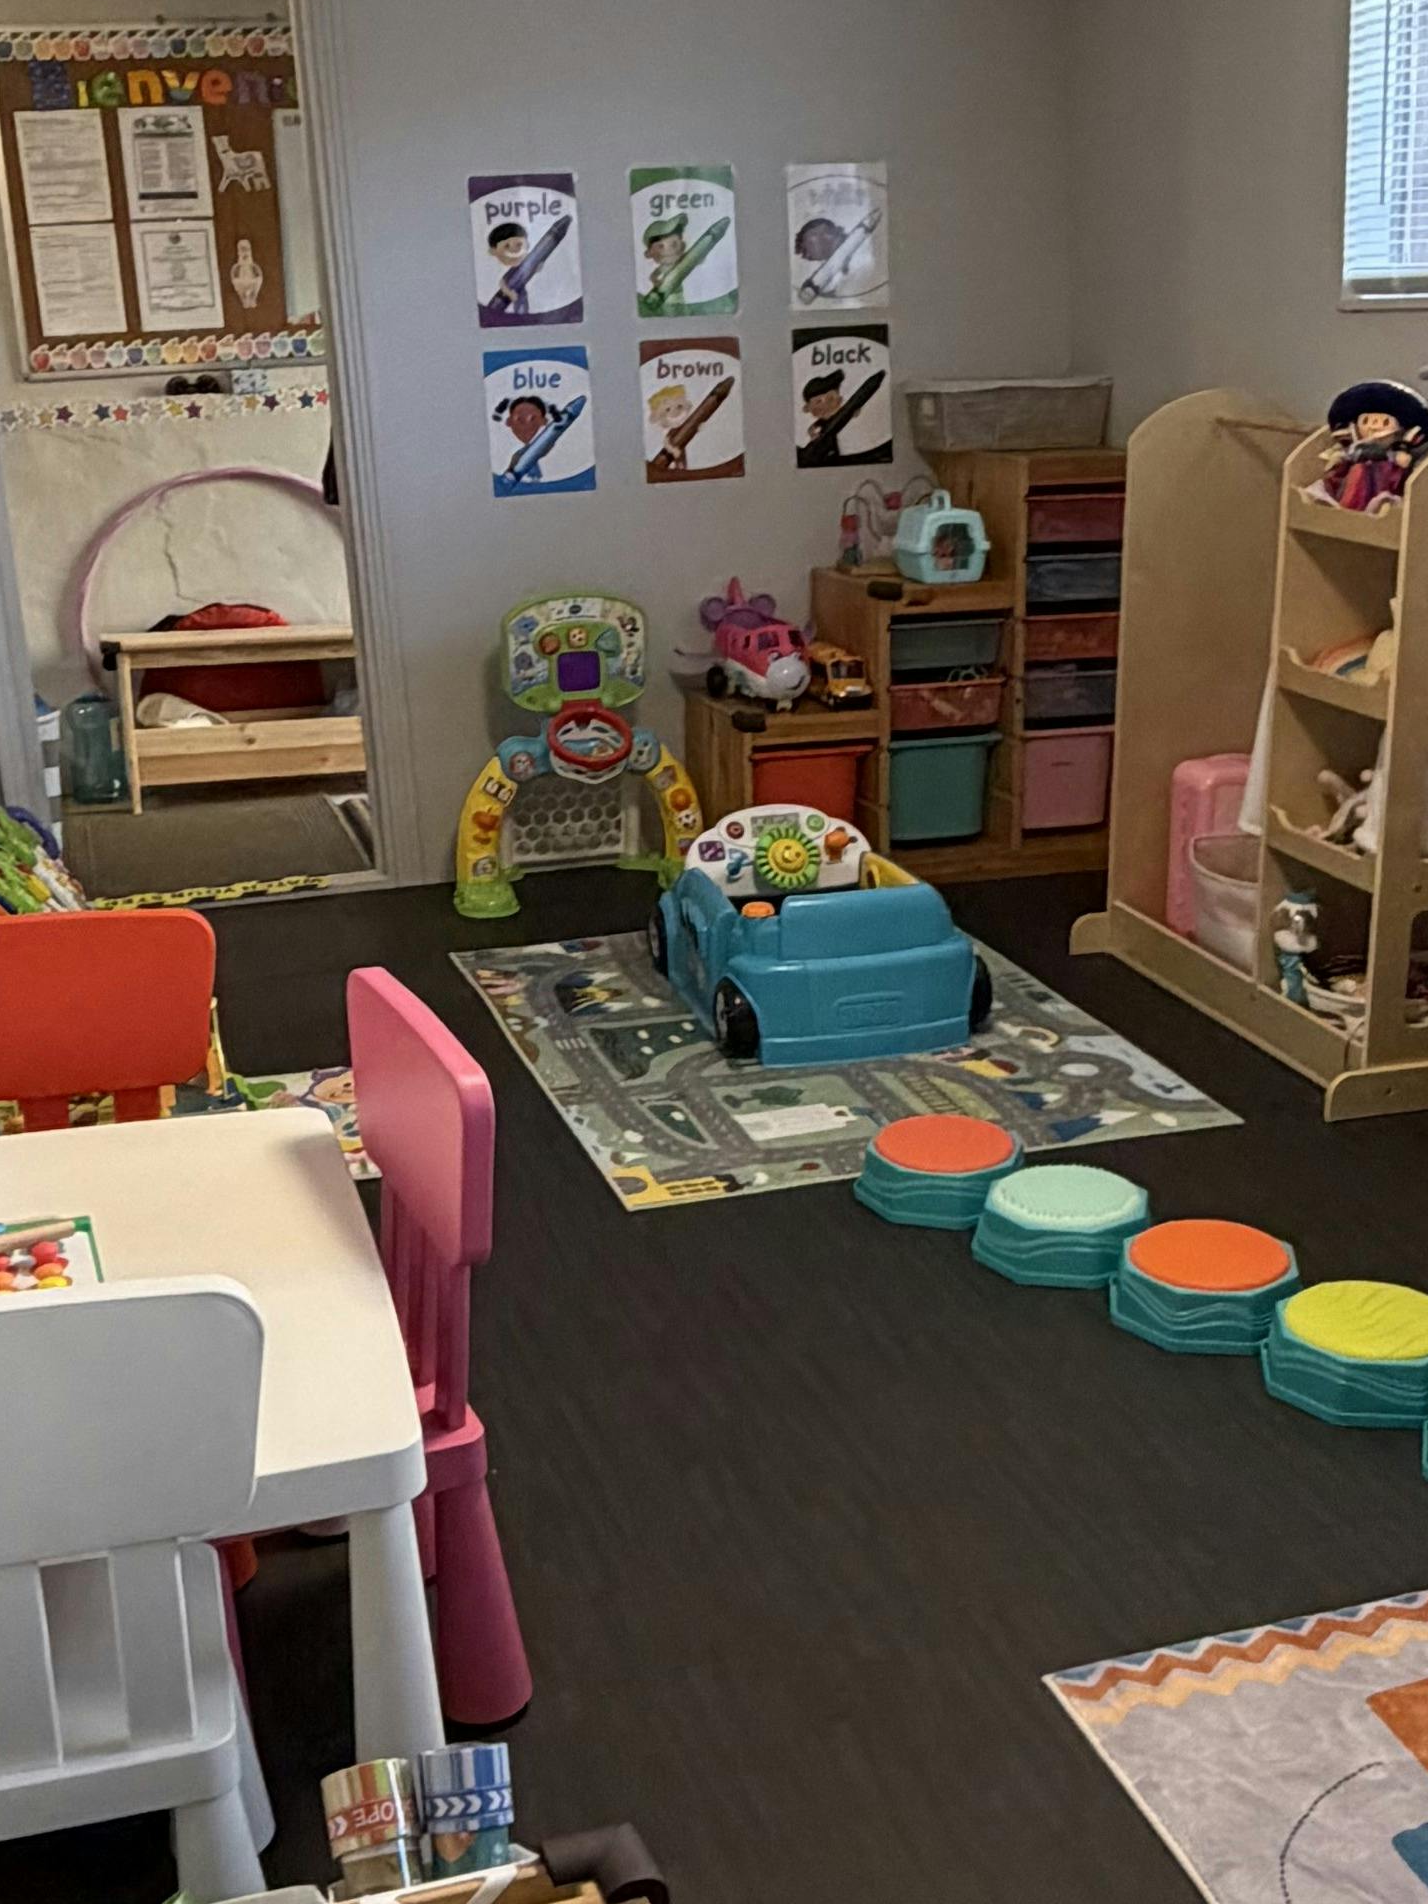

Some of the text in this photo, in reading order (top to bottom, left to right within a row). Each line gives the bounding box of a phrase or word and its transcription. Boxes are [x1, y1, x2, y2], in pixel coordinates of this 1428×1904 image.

[484, 192, 563, 224] purple
[649, 193, 715, 217] green
[810, 342, 872, 366] black
[512, 367, 562, 390] blue
[656, 358, 724, 380] brown
